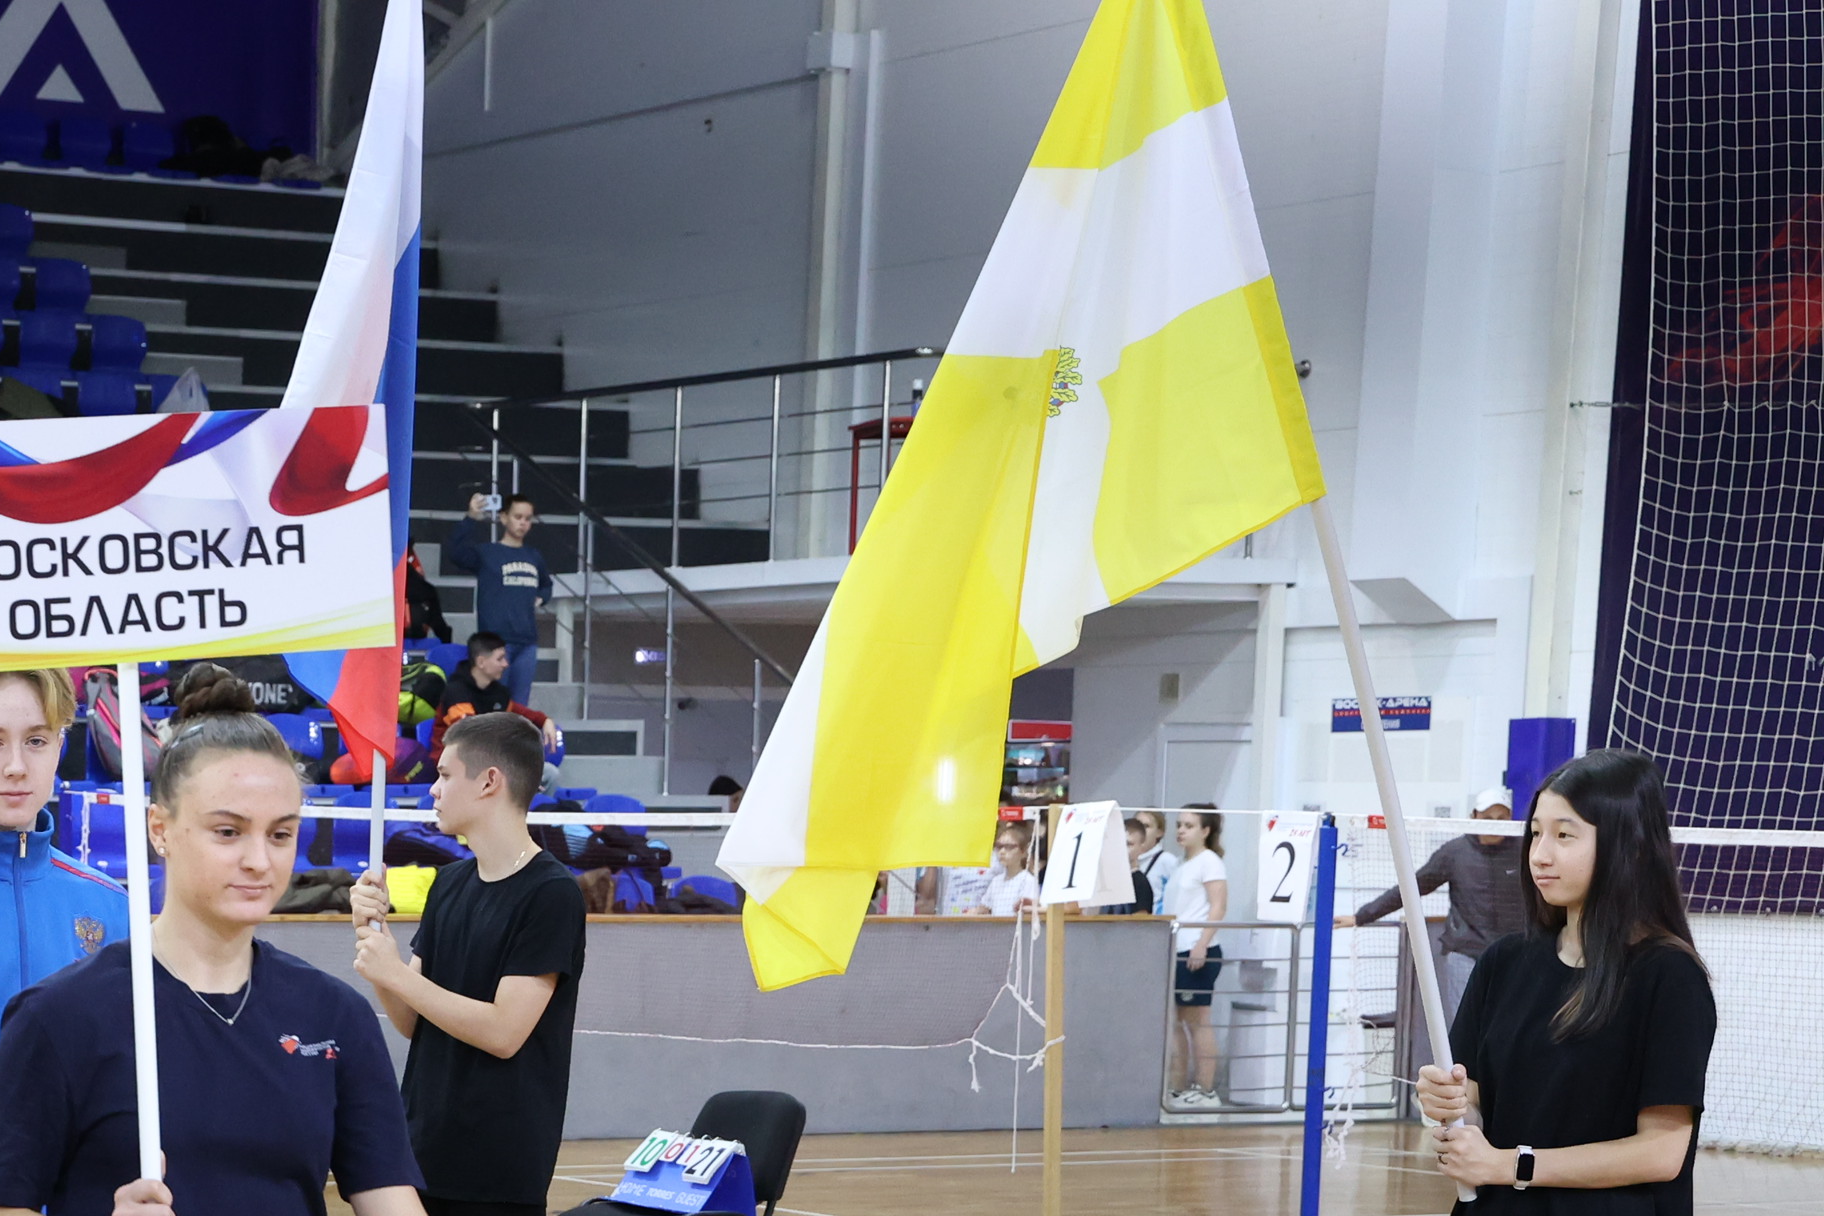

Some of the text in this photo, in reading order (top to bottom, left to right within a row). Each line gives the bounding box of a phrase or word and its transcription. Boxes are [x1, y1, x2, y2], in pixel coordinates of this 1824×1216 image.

[9, 590, 247, 640] ОБЛАСТЬ
[1062, 832, 1084, 890] 1
[1269, 840, 1296, 904] 2
[630, 1136, 668, 1167] 10
[684, 1146, 727, 1177] 21
